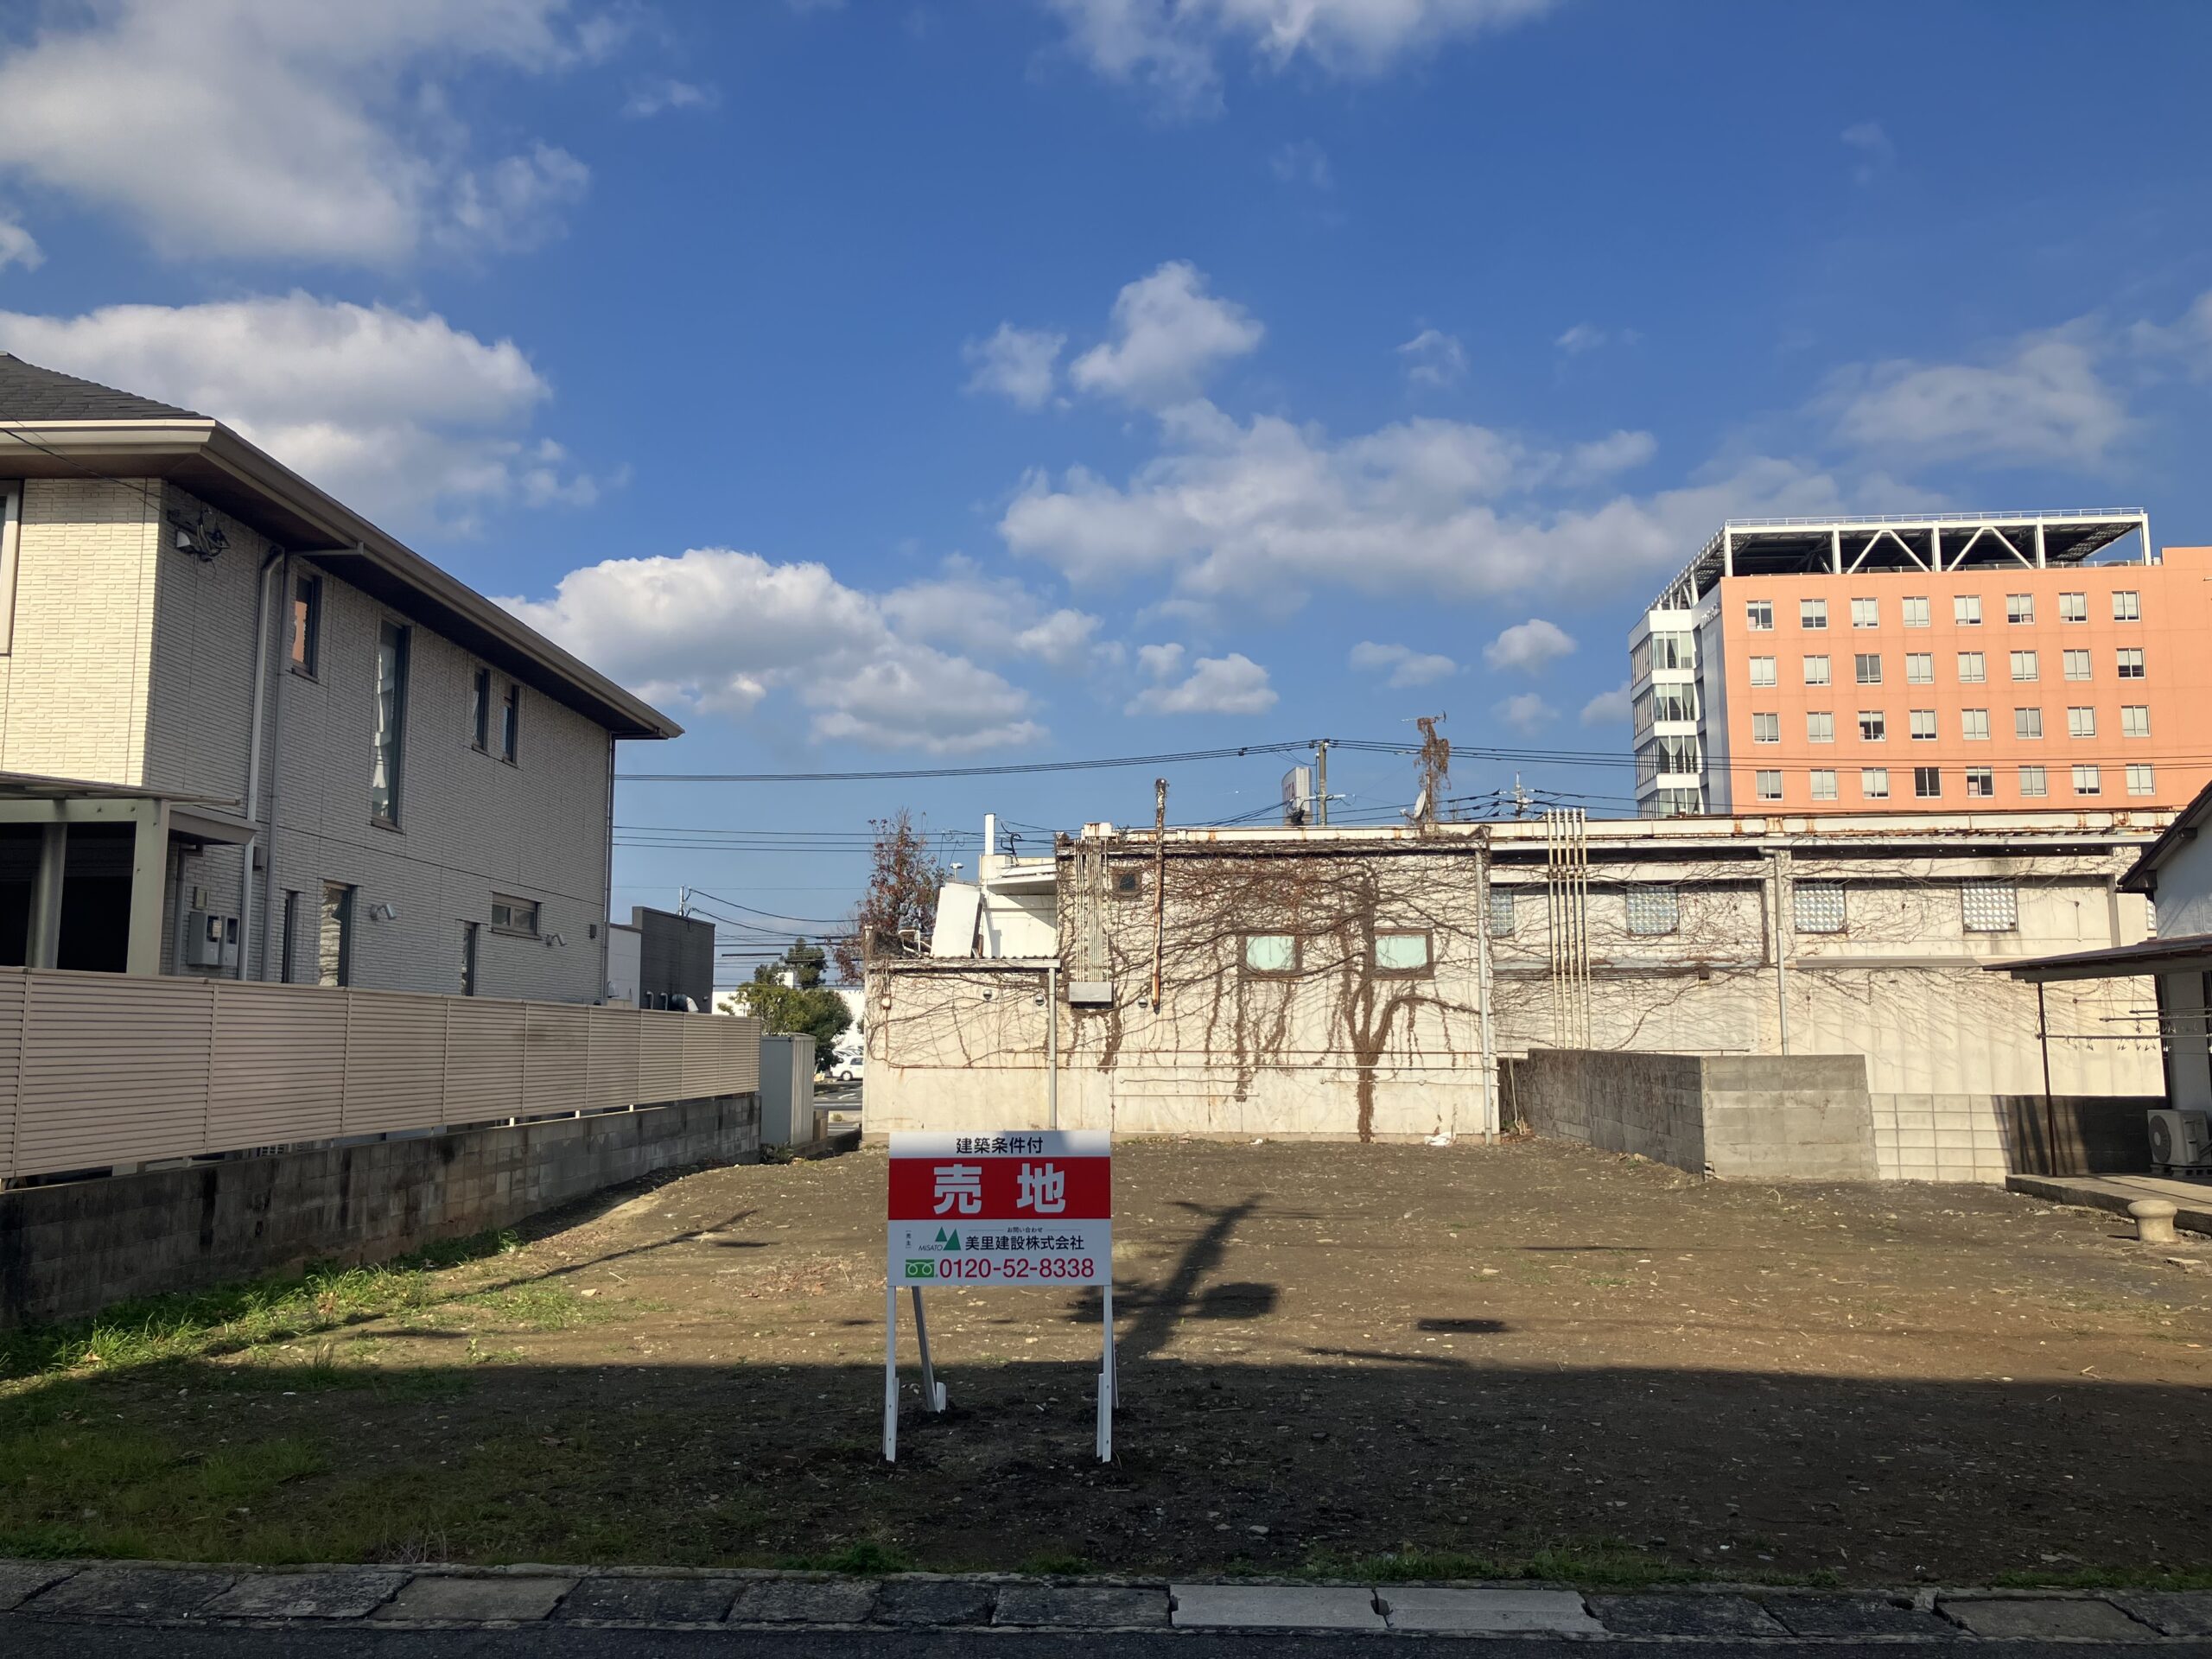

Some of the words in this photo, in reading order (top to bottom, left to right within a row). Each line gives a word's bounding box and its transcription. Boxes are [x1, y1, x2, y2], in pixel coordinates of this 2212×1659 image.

[956, 1137, 1043, 1154] 建築条件付
[965, 1236, 1084, 1250] 美里建設株式会社
[939, 1258, 1094, 1278] 0120-52-8338
